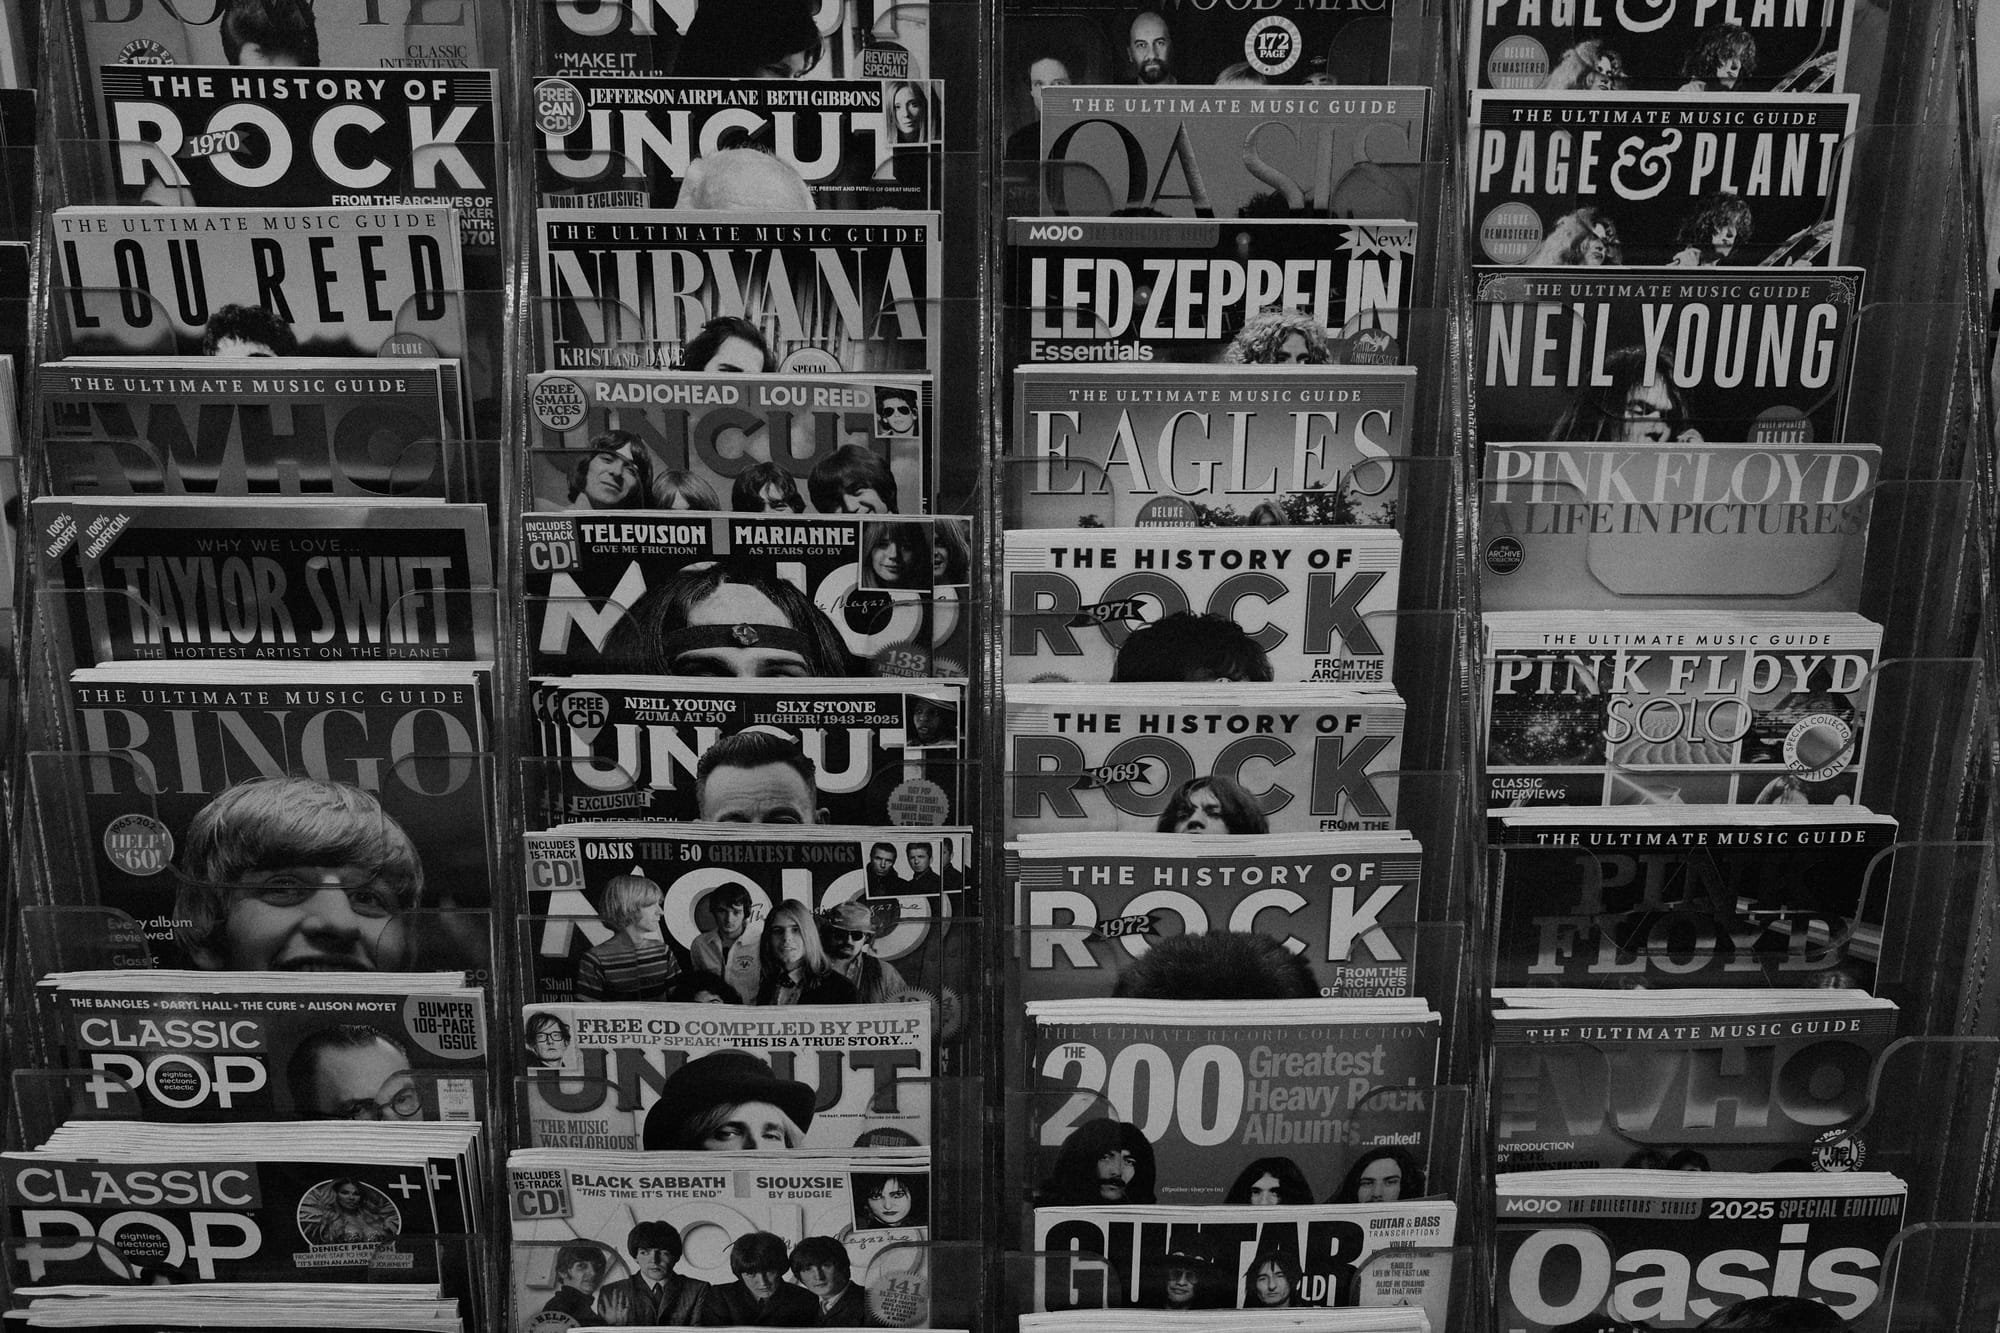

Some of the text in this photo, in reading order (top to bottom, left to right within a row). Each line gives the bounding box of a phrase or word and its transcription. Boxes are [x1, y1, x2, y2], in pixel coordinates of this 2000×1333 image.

[407, 45, 468, 59] CLASSIC
[1259, 49, 1286, 59] PAGE
[1505, 47, 1535, 58] DELUXE
[1491, 62, 1545, 73] REMASTERED
[148, 75, 448, 101] THE HISTORY OF
[538, 88, 574, 101] FREE
[587, 88, 880, 107] JEFFERSON AIRPLANE BETH GIBBONS
[1072, 98, 1397, 114] THE ULTIMATE MUSIC GUIDE
[538, 102, 574, 115] CAN
[114, 101, 487, 190] ROCK
[190, 130, 240, 157] 1970
[1480, 127, 1840, 201] PAGE & PLANT
[61, 213, 437, 233] THE ULTIMATE MUSIC GUIDE
[1029, 225, 1084, 242] MOJO
[1356, 225, 1413, 247] New!
[1484, 228, 1539, 240] REMASTERED
[64, 234, 446, 328] LOU REED
[548, 247, 926, 343] NIRVANA
[1031, 257, 1402, 340] LED ZEPPELIN
[390, 342, 424, 355] DELUXE
[1030, 340, 1153, 362] Essentials
[1485, 302, 1838, 389] NEIL YOUNG
[540, 384, 576, 394] FREE
[595, 383, 870, 408] RADIOHEAD LOU REED
[535, 394, 582, 405] SMALL
[539, 405, 580, 415] FACES
[551, 415, 570, 426] CD
[1029, 409, 1395, 496] EAGLES
[1490, 450, 1871, 504] PINK FLOYD
[1152, 506, 1183, 518] DELUXE
[1489, 503, 1861, 535] A LIFE IN PICTURES
[525, 520, 573, 532] INCLUDES
[526, 531, 574, 542] 15-TRACK
[581, 524, 855, 546] TELEVISION MARIANNE
[529, 542, 579, 571] CD!
[1051, 548, 1352, 569] THE HISTORY OF
[1487, 550, 1521, 558] ARCHIVE
[114, 556, 298, 645] TAYLOR
[305, 556, 452, 645] SWIFT
[1010, 571, 1385, 656] ROCK
[1543, 634, 1832, 646] THE ULTIMATE MUSIC GUIDE
[134, 647, 450, 658] THE HOTTEST ARTIST ON THE PLANET
[1495, 653, 1868, 696] PINK FLOYD
[569, 697, 603, 710] FREE
[624, 697, 876, 713] NEIL YOUNG SLY STONE
[567, 710, 604, 729] CD
[1054, 713, 1362, 734] THE HISTORY OF
[1602, 697, 1754, 744] SOLO
[75, 708, 475, 797] RINGO
[1012, 735, 1395, 818] ROCK
[1491, 777, 1543, 789] CLASSIC
[577, 793, 646, 810] EXCLUSIVE!
[1490, 789, 1566, 800] INTERVIEWS
[528, 840, 575, 851] INCLUDES
[585, 841, 856, 863] OASIS THE 50 GREATEST SONGS
[529, 849, 577, 860] 15-TRACK
[532, 859, 584, 889] CD!
[1068, 863, 1376, 887] THE HISTORY OF
[1030, 885, 1408, 970] ROCK
[70, 998, 397, 1013] THE BANGLES DARYL HALL THE CURE ALISON MOYET
[418, 1002, 473, 1018] BUMPER
[80, 1019, 261, 1049] CLASSIC
[413, 1018, 476, 1034] 108-PAGE
[576, 1018, 920, 1036] FREE CD COMPILED BY PULP
[439, 1034, 478, 1050] ISSUE
[1062, 1046, 1086, 1059] THE
[85, 1053, 267, 1109] POP
[159, 1077, 198, 1085] electronic
[162, 1071, 193, 1080] eighties
[163, 1083, 195, 1091] eclectic
[1040, 1042, 1386, 1147] 200 Greatest
[1247, 1076, 1425, 1117] Heavy Rock
[1498, 1141, 1574, 1153] INTRODUCTION
[512, 1170, 561, 1181] INCLUDES
[571, 1173, 843, 1189] BLACK SABBATH SIOUXSIE
[15, 1168, 254, 1205] CLASSIC
[514, 1180, 562, 1190] 15-TRACK
[517, 1189, 568, 1217] CD!
[1708, 1197, 1900, 1219] 2025 SPECIAL EDITION
[1370, 1216, 1440, 1229] GUITAR & BASS
[120, 1231, 162, 1243] eighties
[1369, 1228, 1440, 1238] TRANSCRIPTIONS
[14, 1209, 262, 1281] POP
[116, 1240, 168, 1250] electronic
[123, 1247, 165, 1257] eclectic
[1509, 1224, 1881, 1326] Oasis
